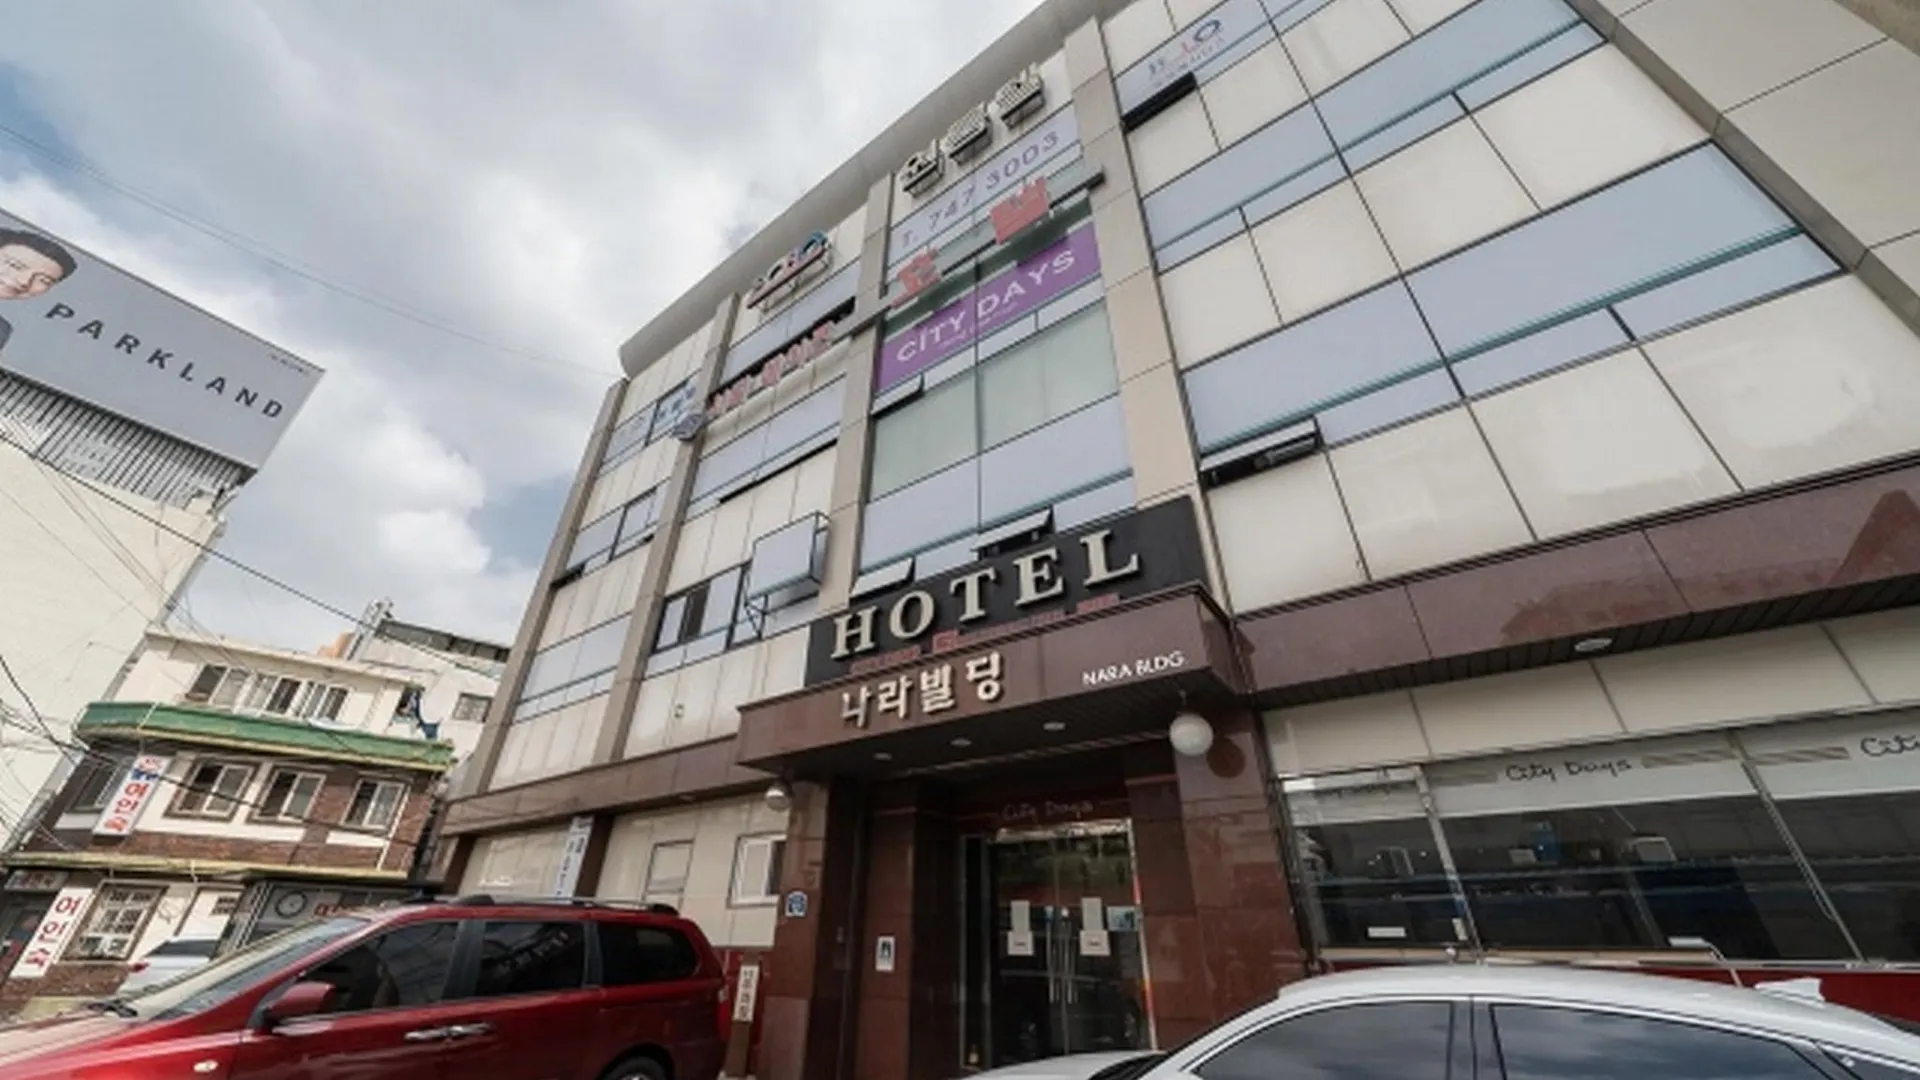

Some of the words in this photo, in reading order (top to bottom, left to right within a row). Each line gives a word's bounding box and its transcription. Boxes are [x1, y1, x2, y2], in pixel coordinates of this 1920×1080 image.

[929, 183, 976, 232] 747
[986, 131, 1058, 189] 3003
[896, 311, 966, 362] CITY
[977, 250, 1075, 319] DAYS
[45, 302, 284, 419] PARKLAND
[830, 528, 1141, 660] HOTEL
[842, 651, 1003, 728] 나라빌딩
[1082, 664, 1132, 685] NARA
[1505, 763, 1557, 783] City
[1564, 759, 1632, 778] Days
[24, 895, 84, 968] 여인숙
